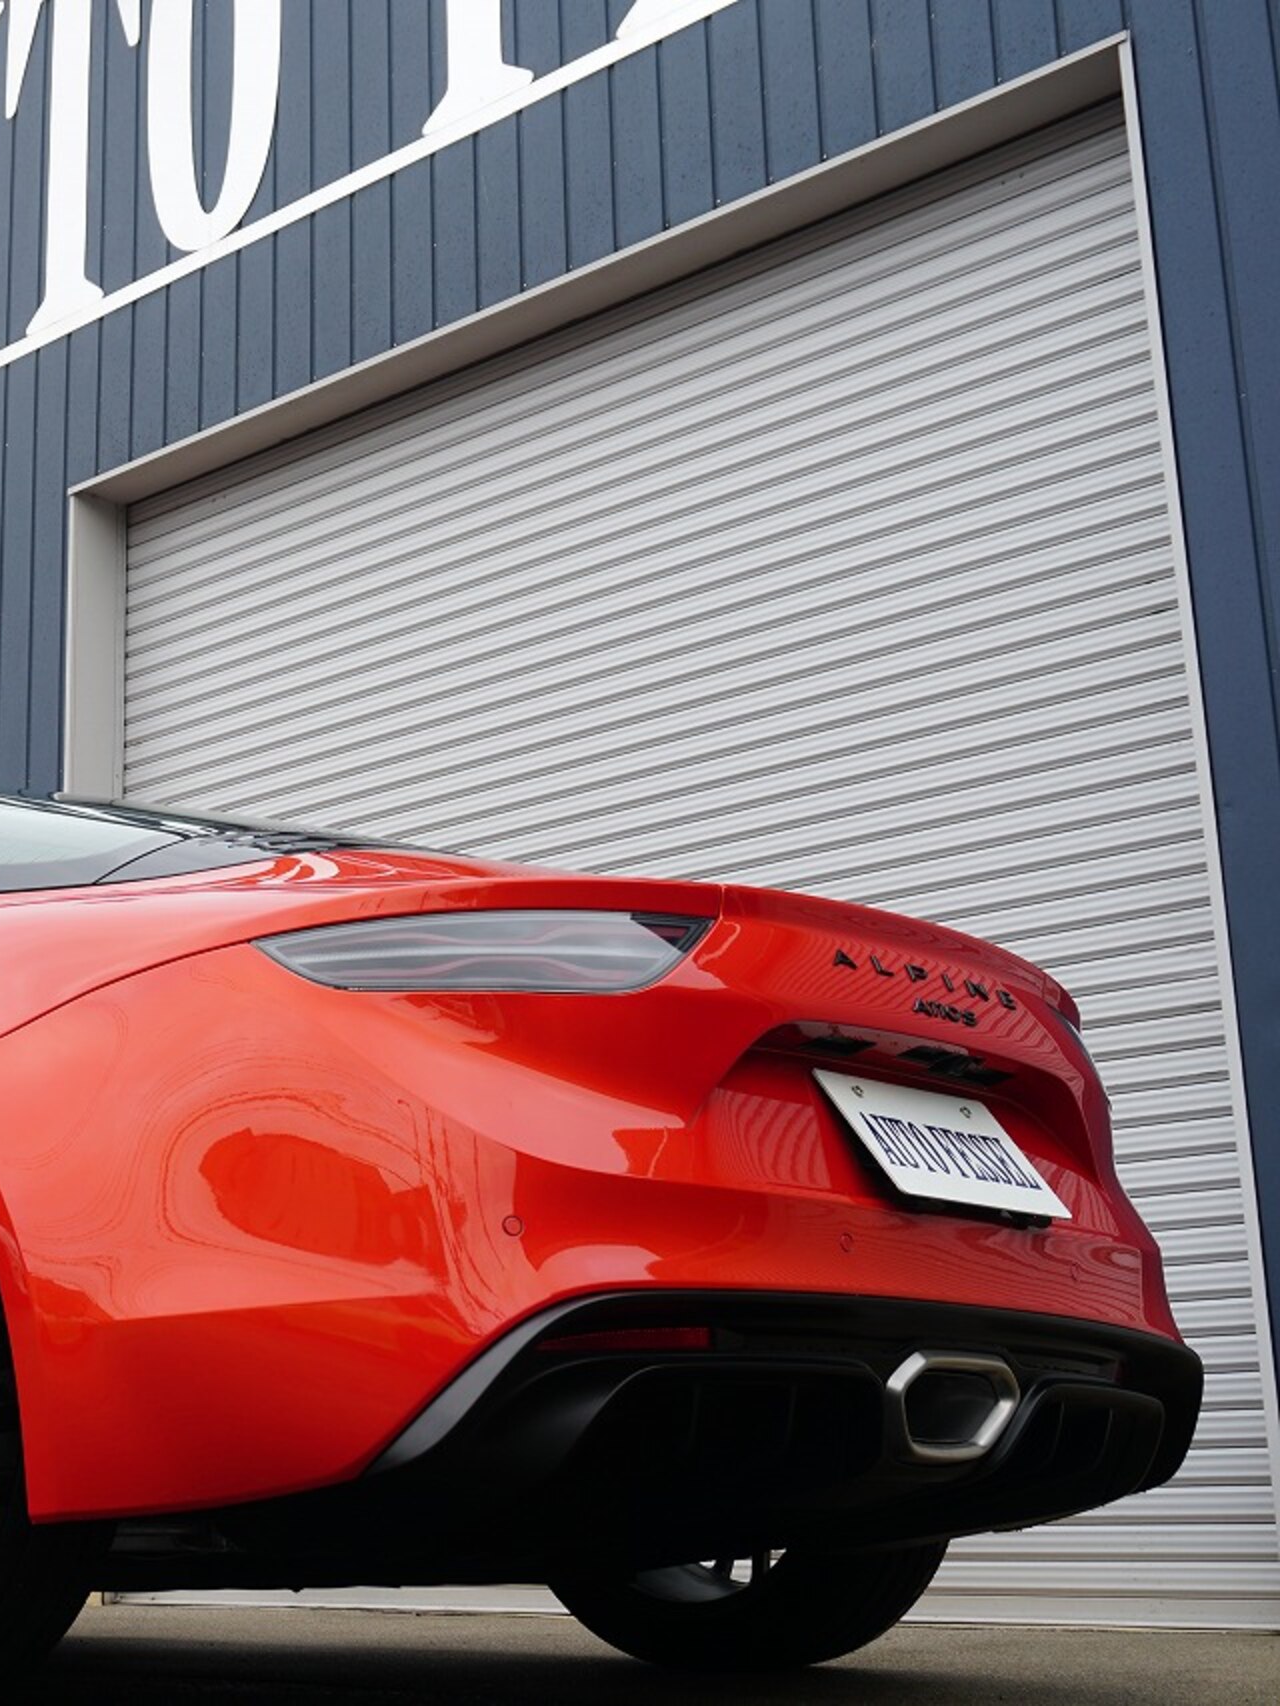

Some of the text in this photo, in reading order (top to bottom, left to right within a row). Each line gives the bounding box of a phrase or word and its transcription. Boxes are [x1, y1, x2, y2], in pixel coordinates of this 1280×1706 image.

[833, 949, 1016, 1010] ALPINE
[859, 1111, 1043, 1191] AUTO FESSEL
